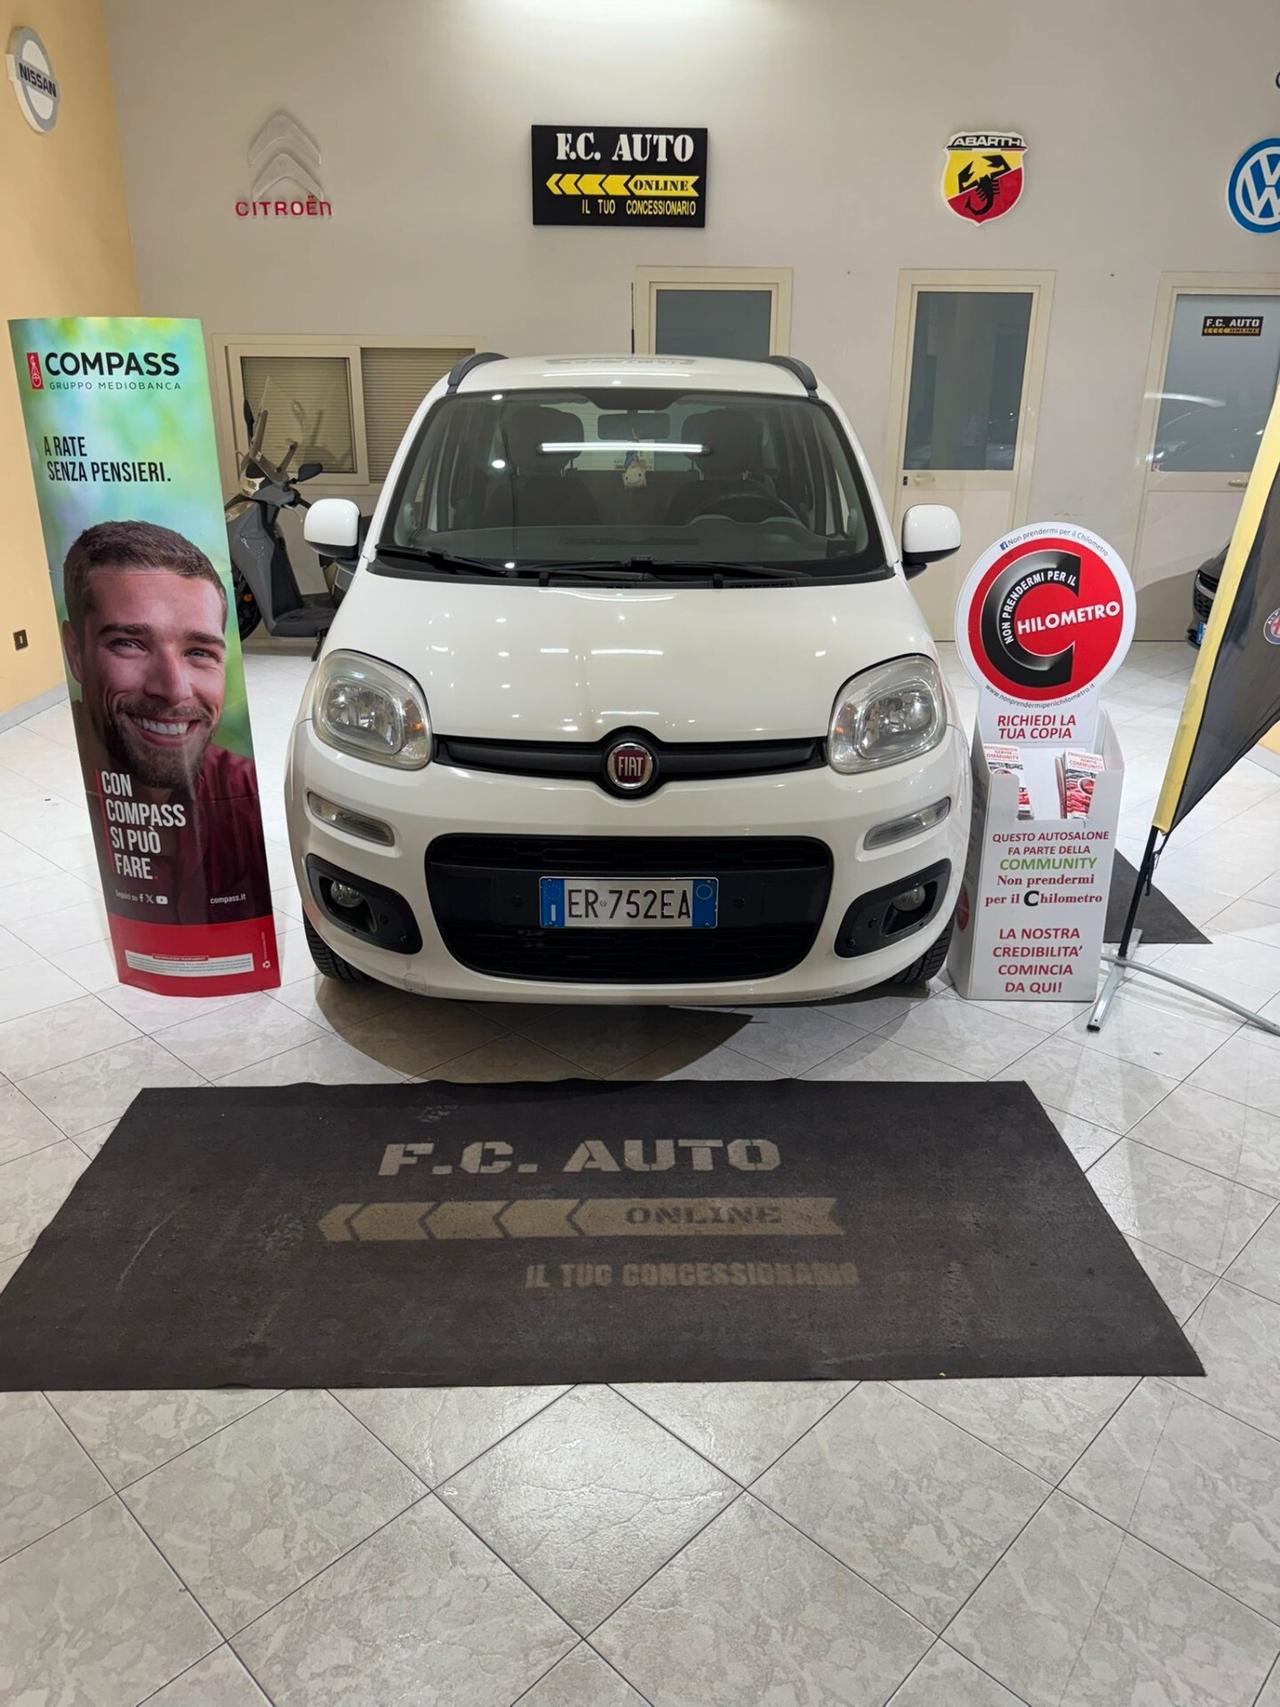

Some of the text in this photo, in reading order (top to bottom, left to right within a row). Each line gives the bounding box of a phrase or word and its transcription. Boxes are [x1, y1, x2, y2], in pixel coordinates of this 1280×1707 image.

[19, 63, 57, 98] NISSAN
[556, 132, 694, 162] F.C. AUTO
[953, 136, 1022, 147] ABARTH
[634, 179, 689, 192] ONLINE
[581, 199, 696, 216] IL TUO CONCESSIONARIO
[1206, 319, 1260, 327] F.C. AUTO
[45, 352, 180, 376] COMPASS
[49, 382, 181, 390] GRUPPO MEDIOBANCA
[44, 436, 88, 457] A RATE
[47, 461, 171, 482] SENZA PENSIERI.
[1007, 536, 1022, 546] Non
[1002, 570, 1077, 645] NON PRENDERMI PER IL
[997, 714, 1076, 727] RICHIEDI LA
[999, 727, 1072, 740] TUA COPIA
[618, 756, 644, 777] FIAT
[101, 770, 133, 798] CON
[105, 799, 187, 827] COMPASS
[109, 826, 161, 854] SI PUÒ
[992, 831, 1109, 843] QUESTO AUTOSALONE
[1008, 845, 1091, 855] FA PARTE DELLA
[1000, 857, 1097, 870] COMMUNITY
[997, 874, 1095, 888] Non prendermi
[210, 893, 247, 905] compass.it
[984, 890, 1103, 907] per il Chilometro
[999, 928, 1080, 939] LA NOSTRA
[998, 964, 1073, 975] COMINCIA
[1005, 982, 1062, 994] DA QUI!
[377, 1138, 781, 1176] F.C. AUTO
[624, 1206, 783, 1226] ONLINE
[525, 1265, 550, 1288] IL
